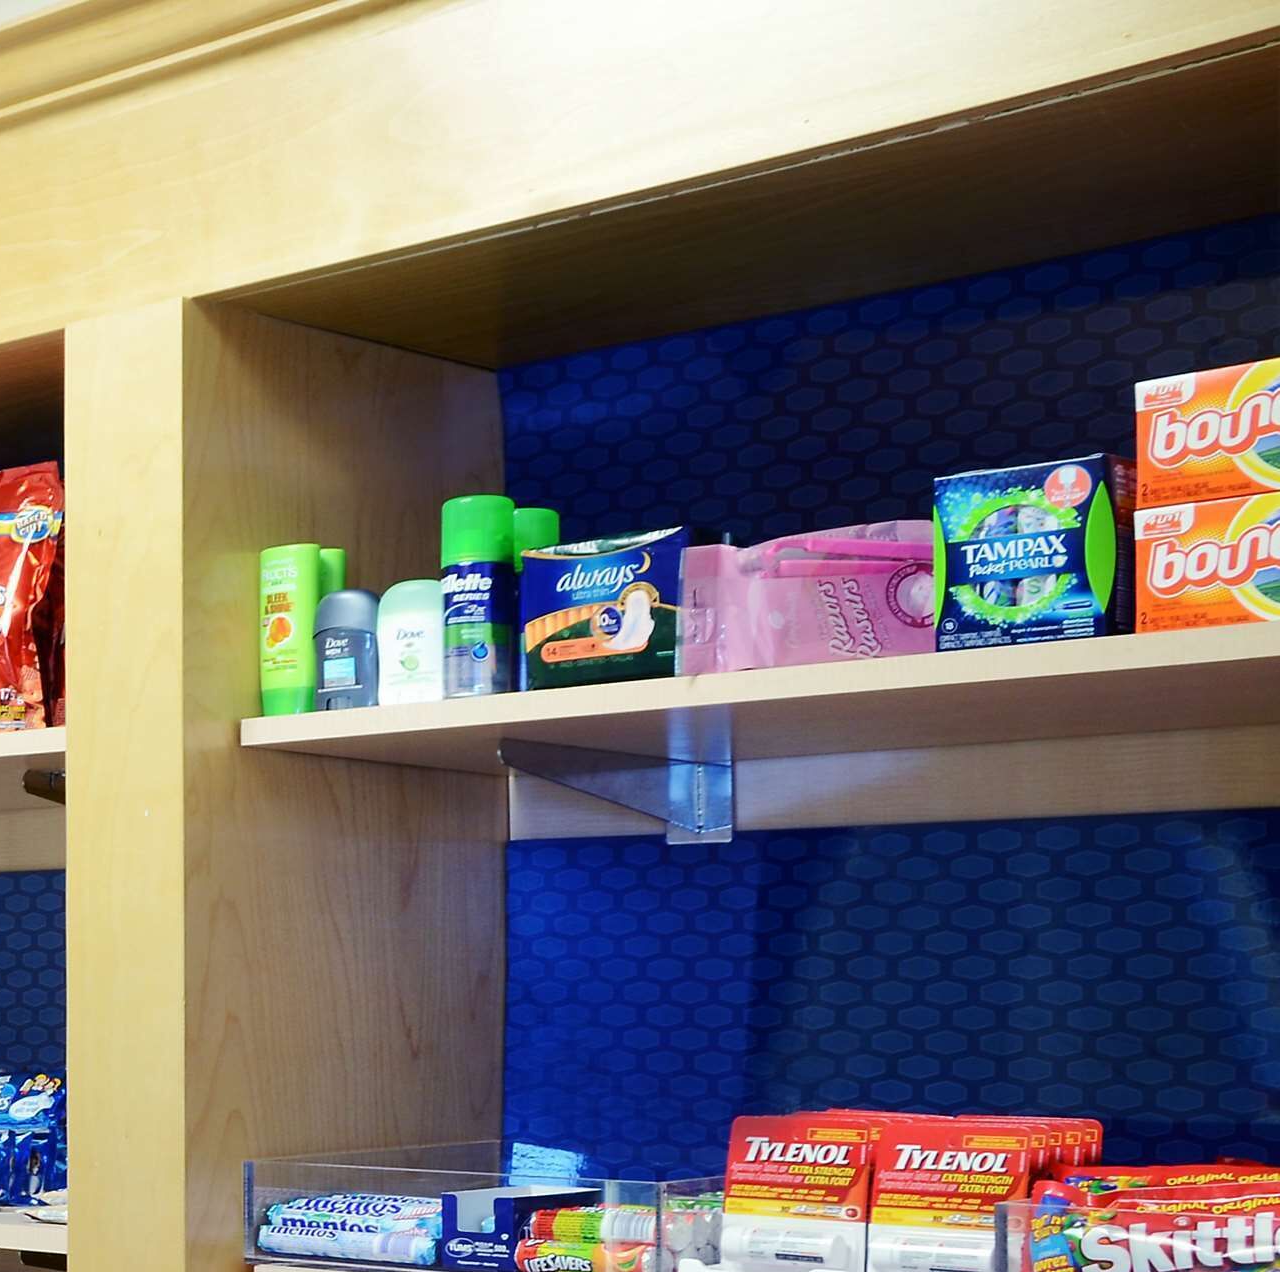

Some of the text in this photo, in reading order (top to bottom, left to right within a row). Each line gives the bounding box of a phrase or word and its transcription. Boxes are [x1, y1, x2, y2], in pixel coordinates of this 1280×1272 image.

[960, 533, 1067, 565] TAMPAX
[555, 563, 640, 593] always
[818, 580, 857, 656] Razors
[842, 577, 883, 657] Rasoirs
[396, 628, 426, 641] Dove
[324, 637, 349, 649] Dove
[744, 1136, 850, 1165] TYLENOL
[894, 1143, 1008, 1173] TYLENOL
[789, 1165, 815, 1175] EXTRA
[815, 1166, 857, 1177] STRENGTH
[941, 1172, 969, 1183] EXTRA
[969, 1173, 1014, 1185] STRENGTH
[1166, 1169, 1280, 1186] ORIGINAL ORIG
[804, 1174, 852, 1186] EXTRA FORT
[958, 1183, 1009, 1195] EXTRA FORT
[1136, 1201, 1208, 1214] ORIGINAL
[270, 1226, 338, 1239] mentos
[280, 1216, 379, 1234] mentos
